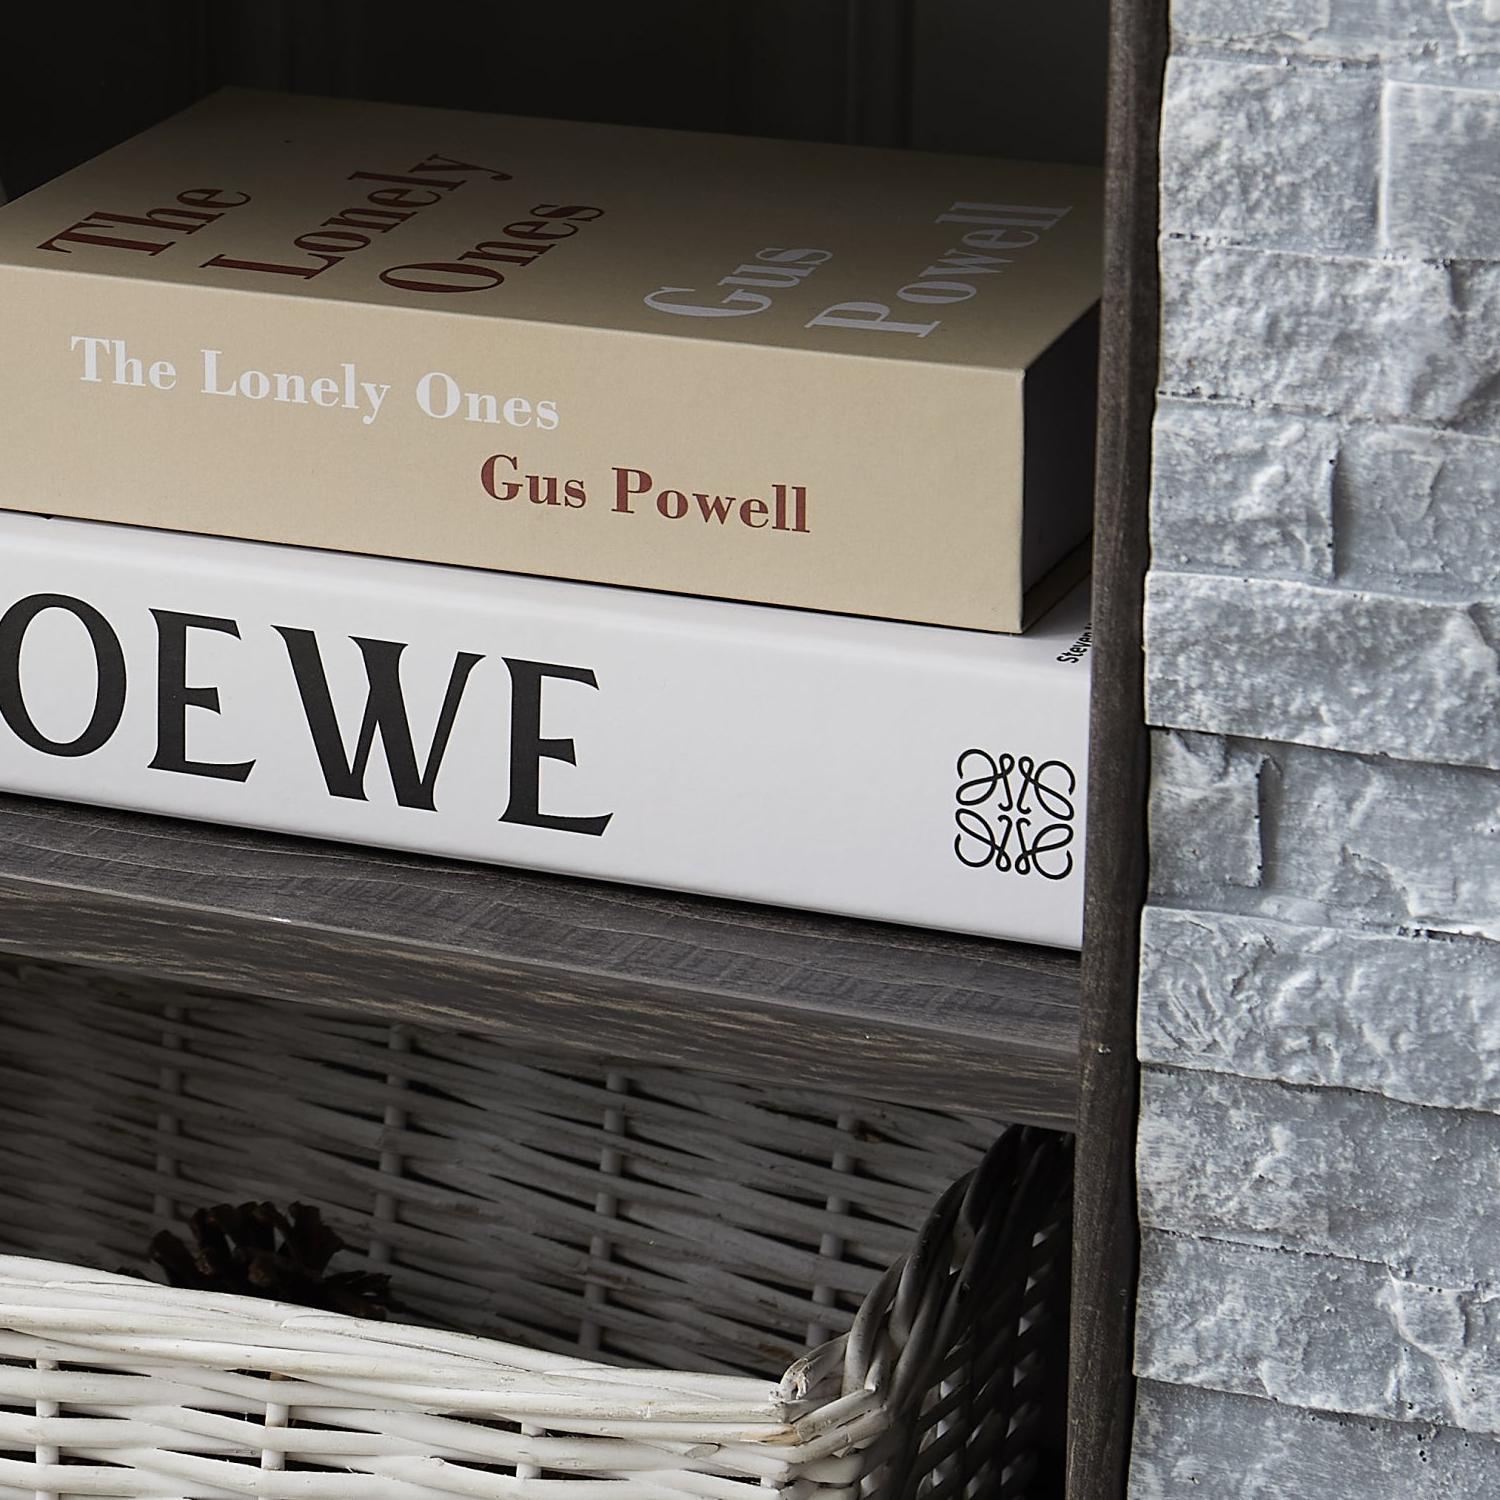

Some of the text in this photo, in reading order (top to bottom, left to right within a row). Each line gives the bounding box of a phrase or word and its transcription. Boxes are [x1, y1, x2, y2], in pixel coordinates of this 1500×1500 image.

[35, 186, 252, 257] The
[198, 153, 512, 280] Lonely
[379, 203, 605, 293] Ones
[643, 246, 833, 318] Gus
[804, 201, 1075, 339] Powell
[70, 335, 560, 431] The Lonely Ones
[480, 453, 811, 534] Gus Powell
